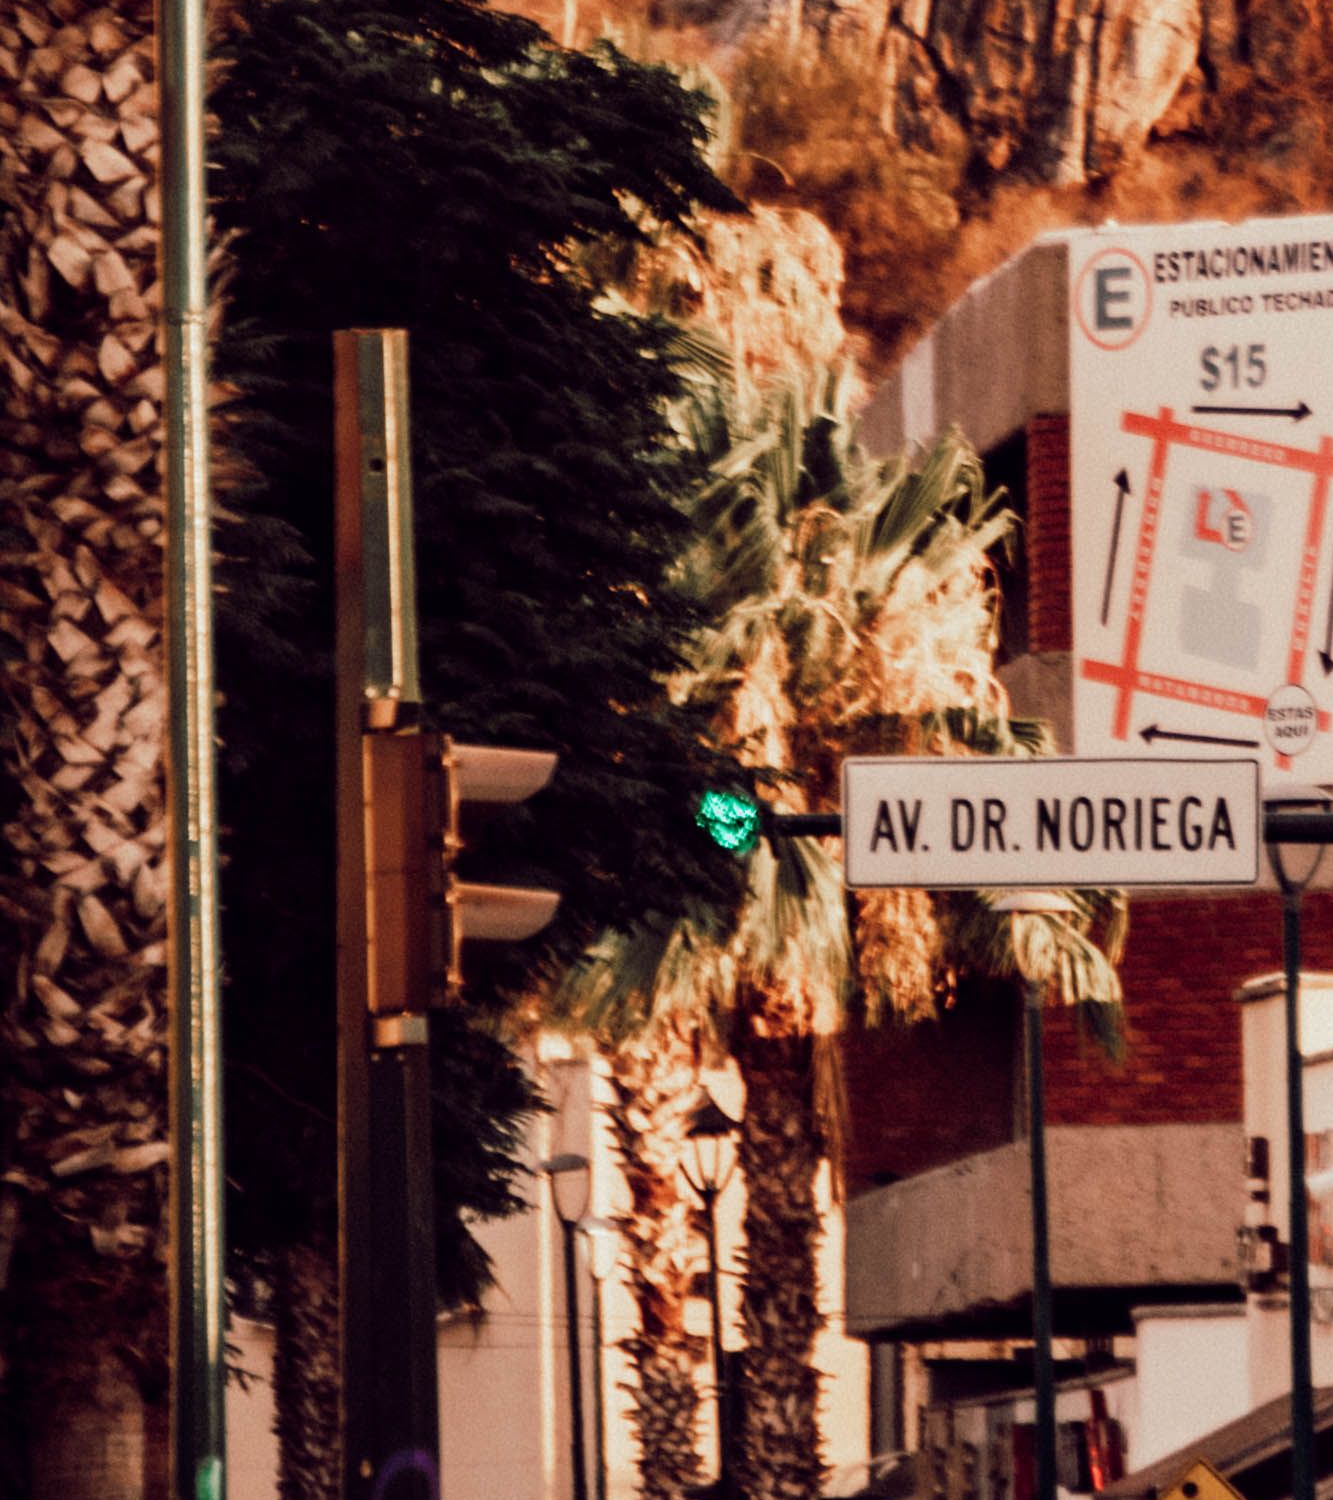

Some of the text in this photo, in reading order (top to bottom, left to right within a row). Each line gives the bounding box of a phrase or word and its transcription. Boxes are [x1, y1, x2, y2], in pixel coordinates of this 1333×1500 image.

[1095, 267, 1133, 330] E
[1200, 344, 1267, 391] $15
[870, 796, 1236, 853] AV. DR. NORIEGA
